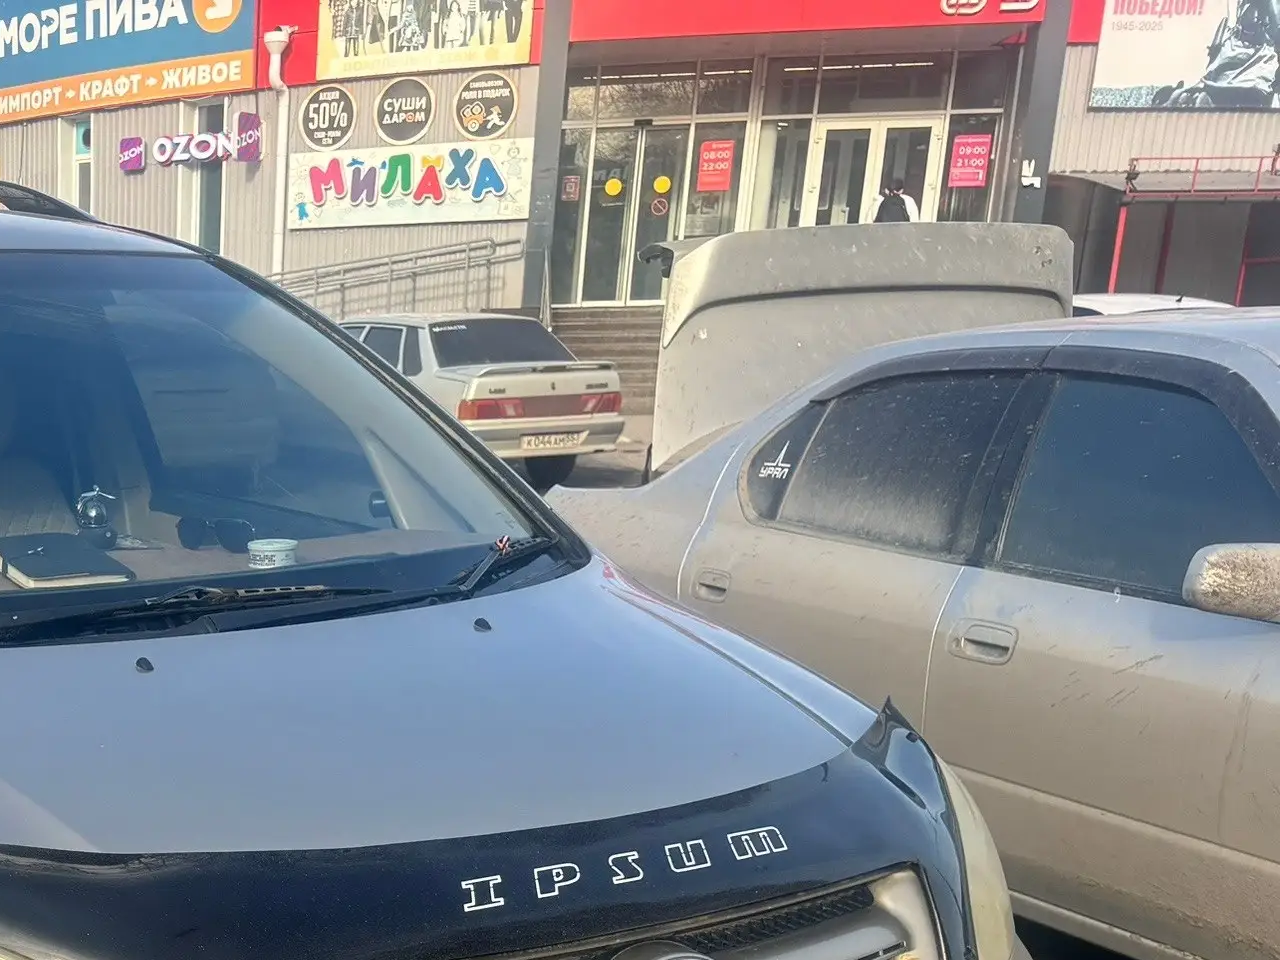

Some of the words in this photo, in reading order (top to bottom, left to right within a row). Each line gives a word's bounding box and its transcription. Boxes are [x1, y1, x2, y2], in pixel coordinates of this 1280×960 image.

[86, 0, 188, 41] ПИВА
[1111, 20, 1163, 31] 1945-2025
[0, 87, 63, 115] ИМПОРТ
[80, 74, 142, 101] КРАФТ
[162, 60, 242, 89] ЖИВОЕ
[383, 96, 427, 113] СУШИ
[308, 101, 348, 130] 50%
[382, 111, 426, 124] ДАРОМ
[152, 133, 233, 163] OZON
[959, 146, 987, 155] 09:00
[956, 158, 984, 167] 21:00
[308, 148, 507, 206] МИЛАХА
[758, 467, 789, 479] УРАЛ
